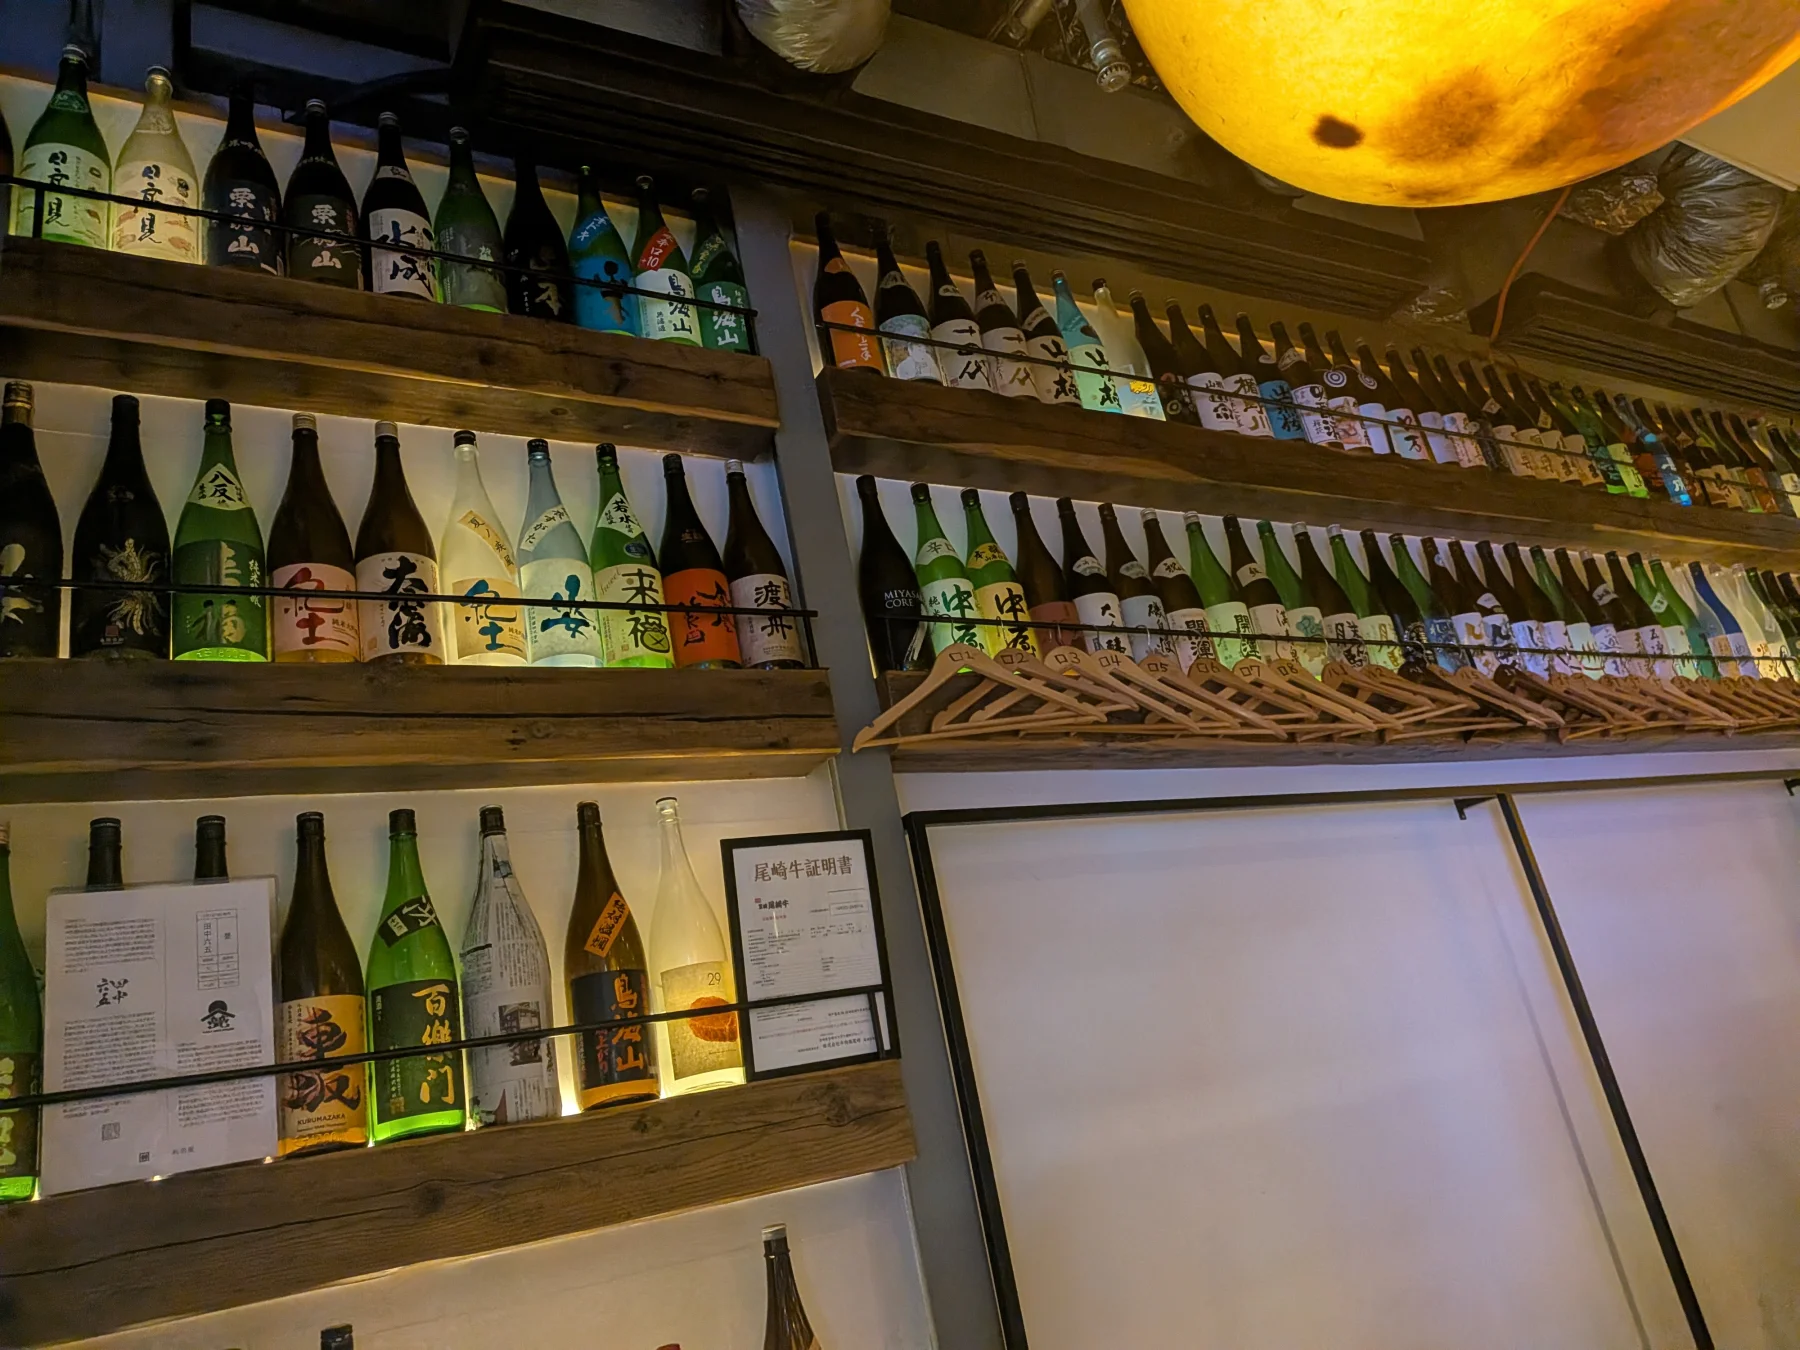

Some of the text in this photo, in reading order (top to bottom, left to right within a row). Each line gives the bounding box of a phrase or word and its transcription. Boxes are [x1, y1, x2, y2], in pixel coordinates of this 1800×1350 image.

[612, 498, 640, 525] 若水
[621, 568, 671, 654] 来福
[885, 599, 914, 609] CORE
[754, 855, 854, 882] 尾崎牛証明書
[203, 922, 213, 954] 田中六五
[706, 972, 721, 987] 29
[297, 1113, 347, 1135] KURUMAZAKA
